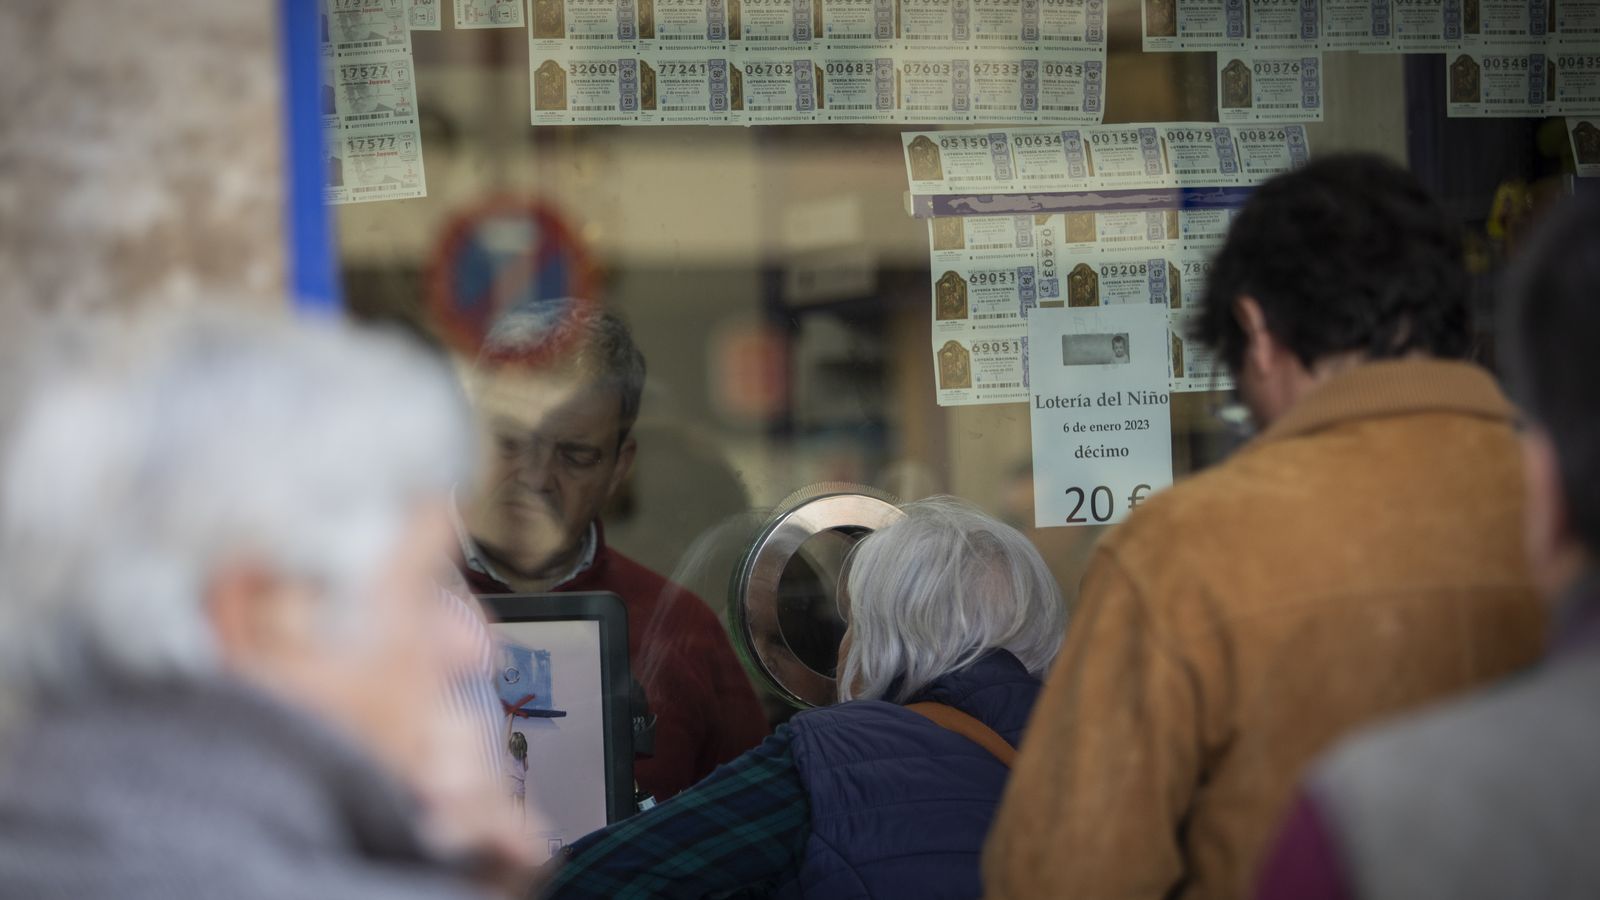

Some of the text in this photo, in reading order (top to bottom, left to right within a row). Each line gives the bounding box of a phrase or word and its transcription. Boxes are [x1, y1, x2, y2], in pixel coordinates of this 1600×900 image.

[1254, 63, 1300, 73] 00376
[1484, 58, 1528, 68] 00548
[341, 66, 388, 79] 17577
[570, 64, 617, 74] 32600
[659, 64, 706, 74] 77241
[745, 65, 793, 75] 06702
[826, 64, 873, 73] 00683
[904, 64, 950, 74] 07603
[974, 64, 1019, 74] 67533
[1042, 64, 1082, 75] 0043
[1015, 136, 1061, 146] 00634
[1092, 133, 1138, 144] 00159
[1167, 132, 1212, 141] 00679
[1240, 131, 1285, 141] 00826
[349, 137, 396, 150] 17577
[941, 138, 988, 148] 05150
[1101, 265, 1147, 276] 09208
[970, 272, 1015, 283] 69051
[972, 342, 1019, 353] 69051
[1035, 391, 1169, 409] Lotería del Niño
[1063, 420, 1150, 433] 6 de enero 2023
[1075, 444, 1130, 459] décimo
[1065, 484, 1151, 524] 20 €
